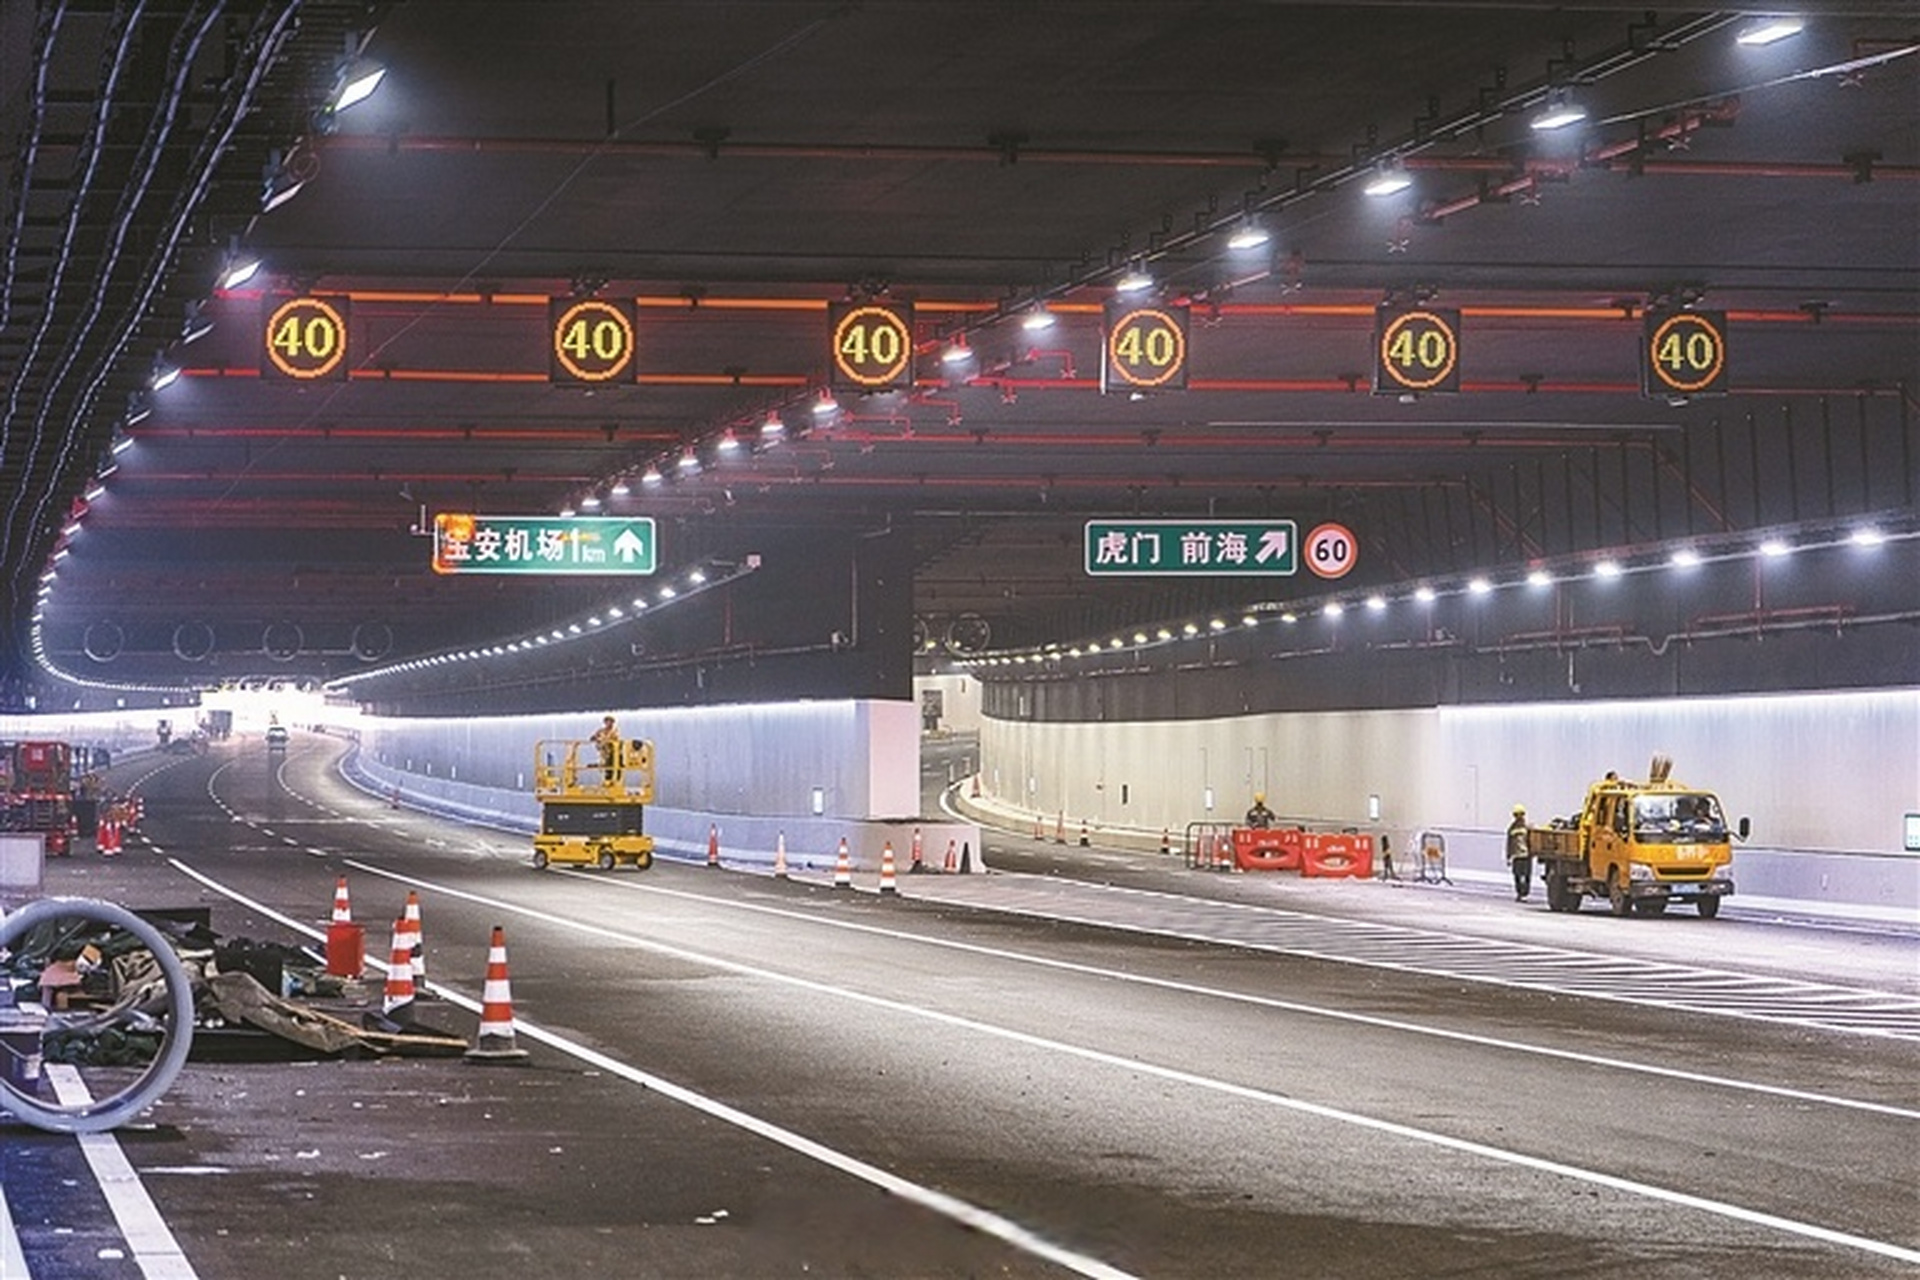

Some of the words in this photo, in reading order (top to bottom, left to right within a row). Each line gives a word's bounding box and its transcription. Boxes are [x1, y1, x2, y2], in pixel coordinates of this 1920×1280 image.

[274, 317, 335, 358] 40
[562, 320, 622, 360] 40
[842, 325, 899, 364] 40
[1117, 327, 1172, 366] 40
[1390, 330, 1446, 368] 40
[1660, 333, 1714, 370] 40
[1096, 531, 1160, 564] 虎门
[1180, 531, 1248, 564] 前海
[1315, 539, 1347, 562] 60
